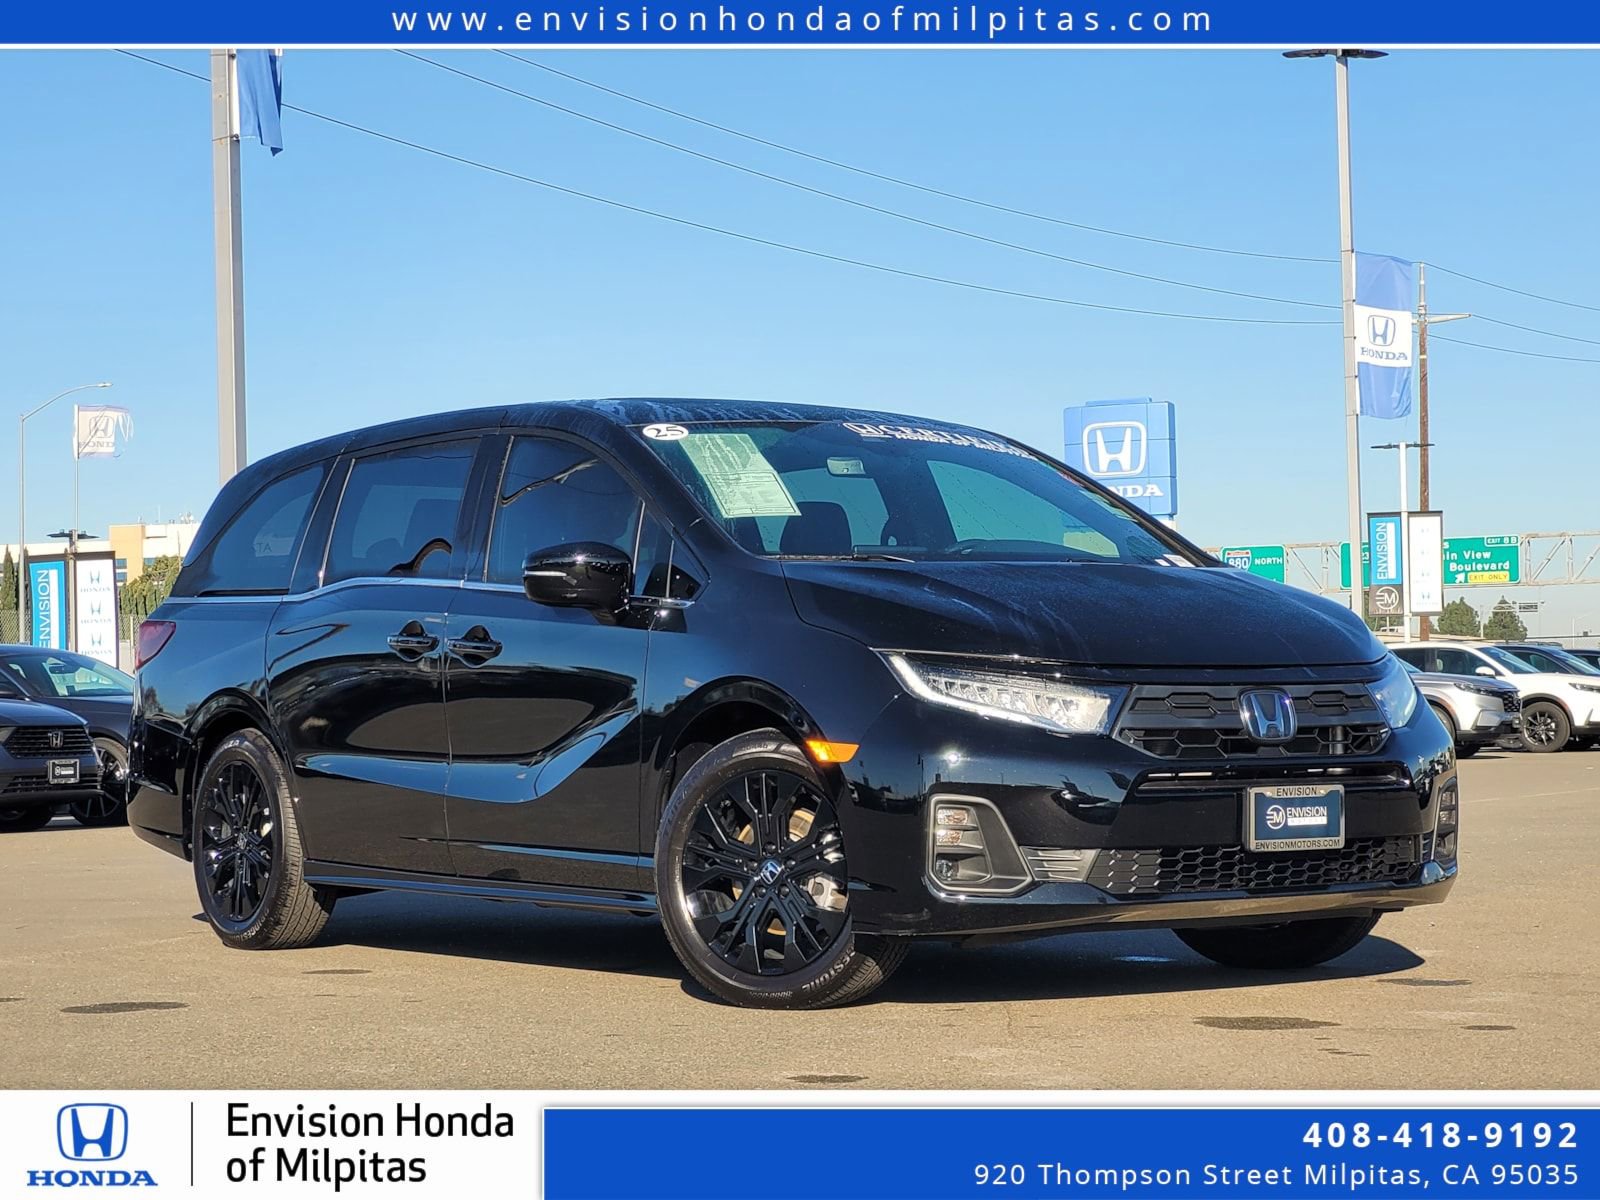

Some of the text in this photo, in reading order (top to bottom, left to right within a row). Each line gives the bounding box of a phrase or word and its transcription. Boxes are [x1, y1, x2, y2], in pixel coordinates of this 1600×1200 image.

[1361, 347, 1408, 361] HONDA
[647, 425, 684, 438] 25
[1107, 484, 1164, 497] NDA
[1376, 522, 1387, 579] ENVISION
[1463, 550, 1491, 560] View
[1254, 557, 1283, 565] NORTH
[1449, 560, 1510, 572] Boulevard
[1276, 787, 1317, 796] ENVISION
[1286, 806, 1327, 817] ENVISION
[1255, 839, 1340, 850] ENVISIONMOTORS.COM
